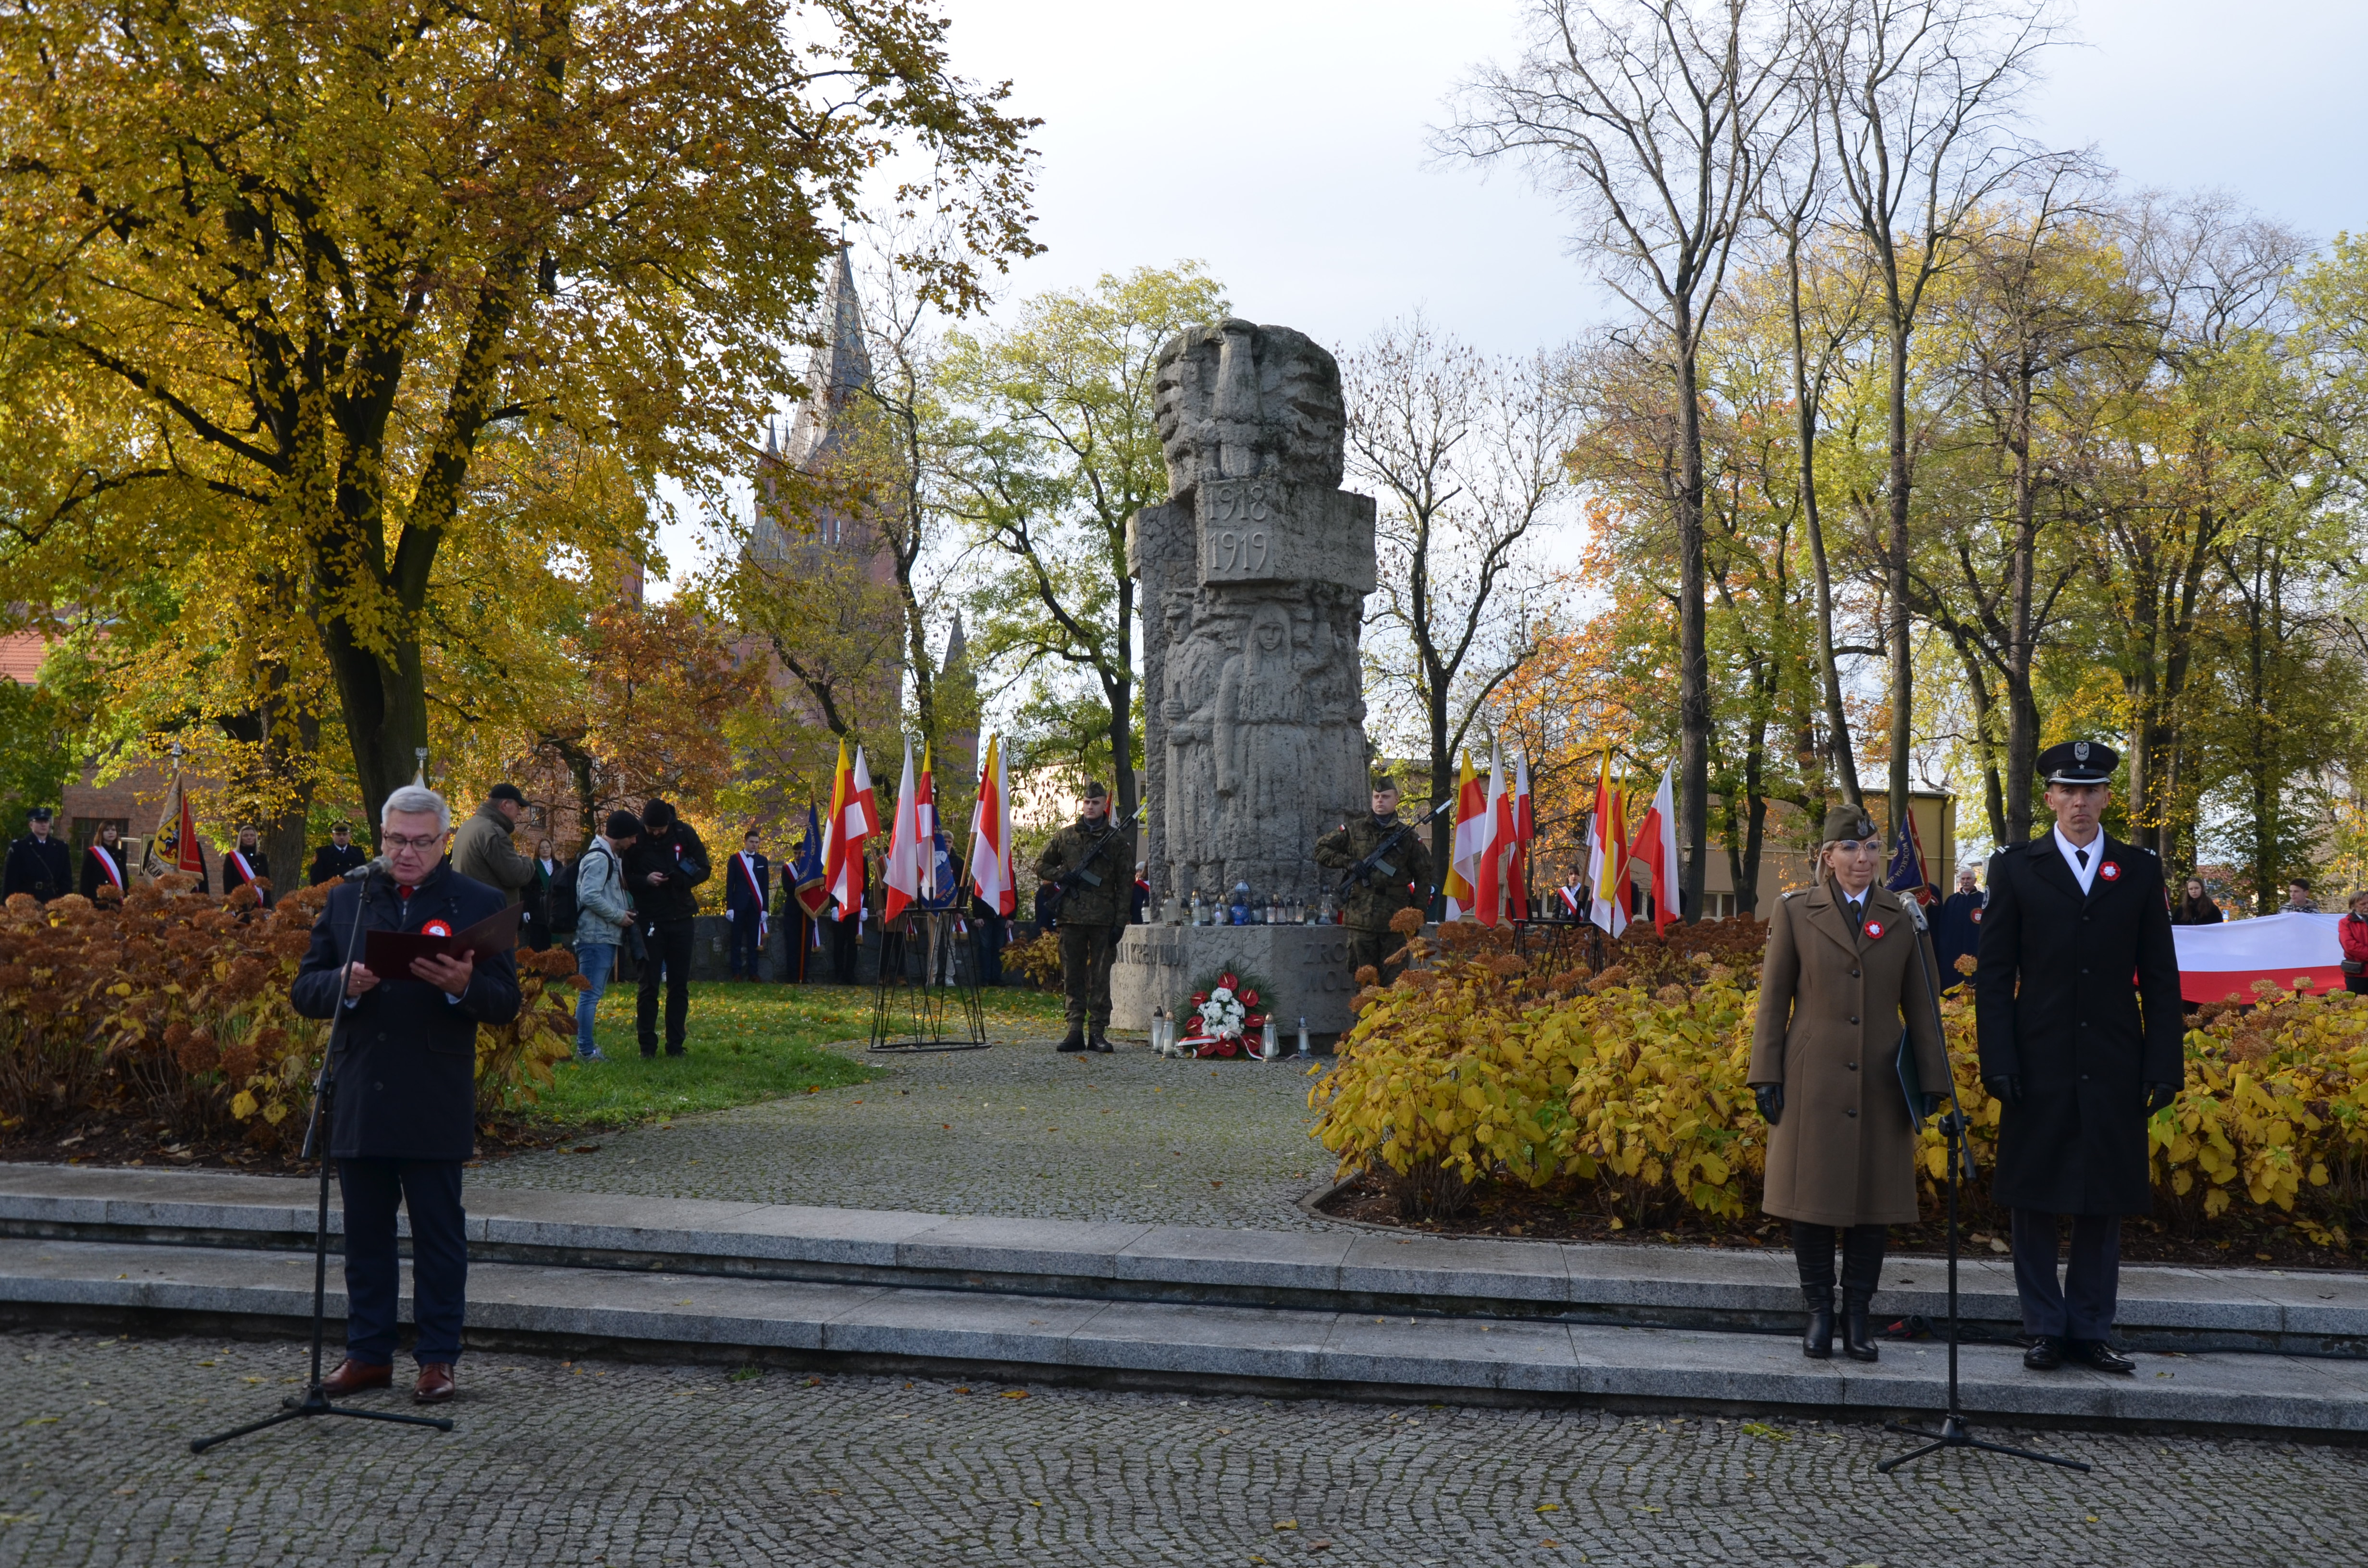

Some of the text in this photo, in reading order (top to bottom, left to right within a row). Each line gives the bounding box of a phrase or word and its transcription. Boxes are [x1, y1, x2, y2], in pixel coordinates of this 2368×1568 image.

[1207, 485, 1267, 522] 1918
[1209, 531, 1267, 573] 1919
[1895, 843, 1910, 877] WOJCIECHA
[1303, 942, 1347, 965] ZRO
